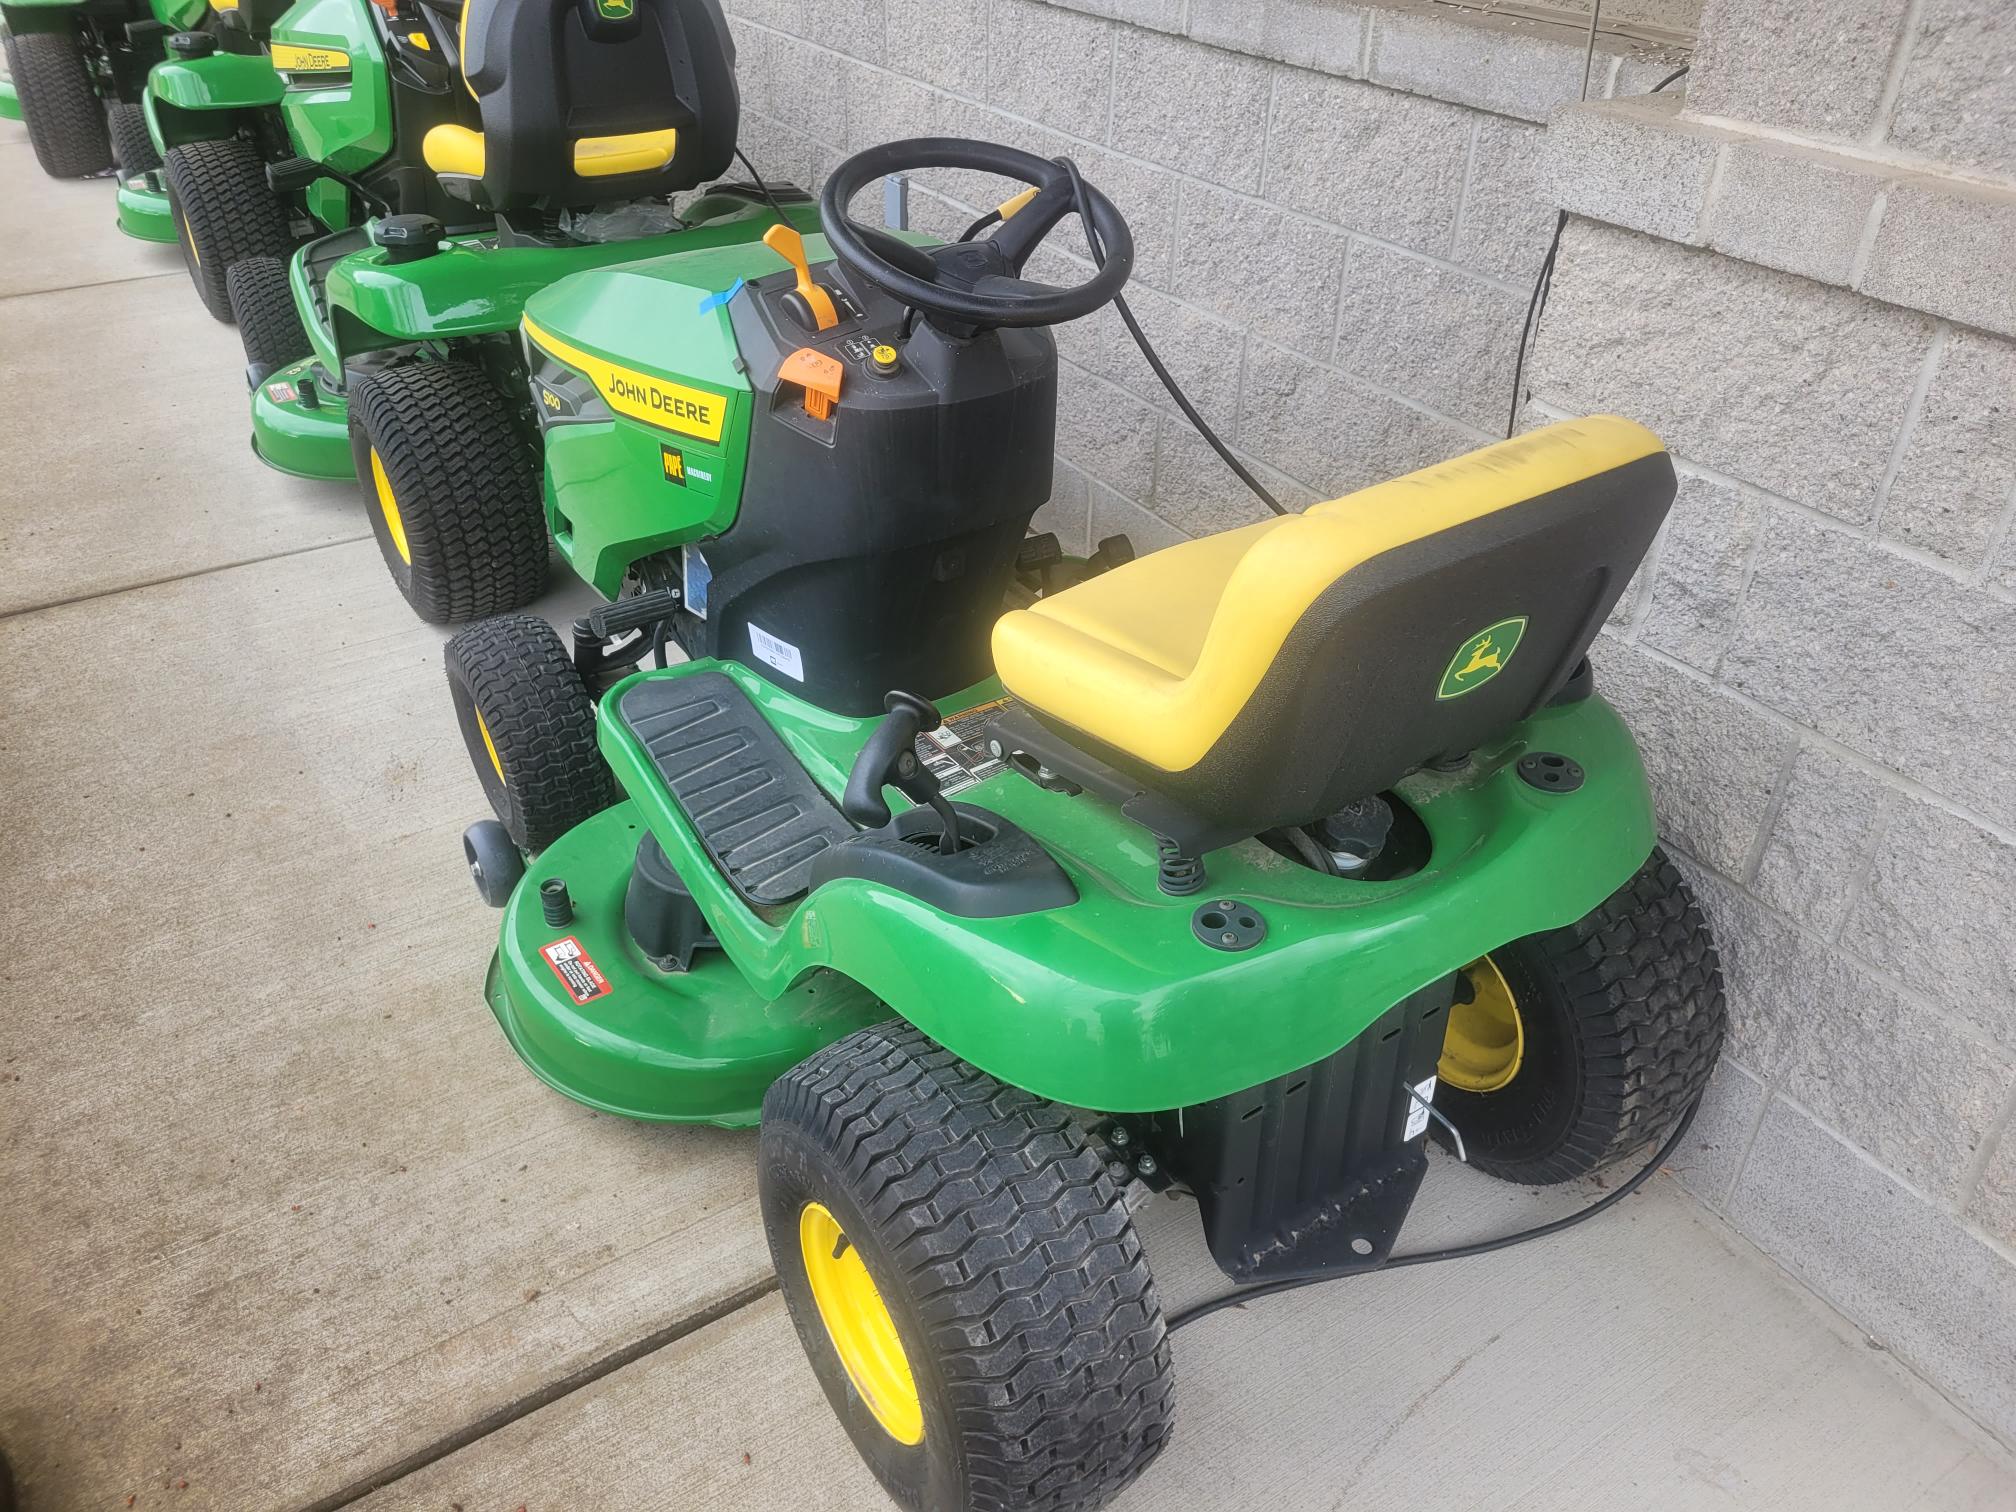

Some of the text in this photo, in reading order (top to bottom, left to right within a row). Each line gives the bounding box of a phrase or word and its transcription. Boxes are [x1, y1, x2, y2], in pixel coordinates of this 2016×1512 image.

[295, 53, 331, 69] JOHN DEERE
[542, 388, 561, 411] S100
[608, 373, 711, 425] JOHN DEERE
